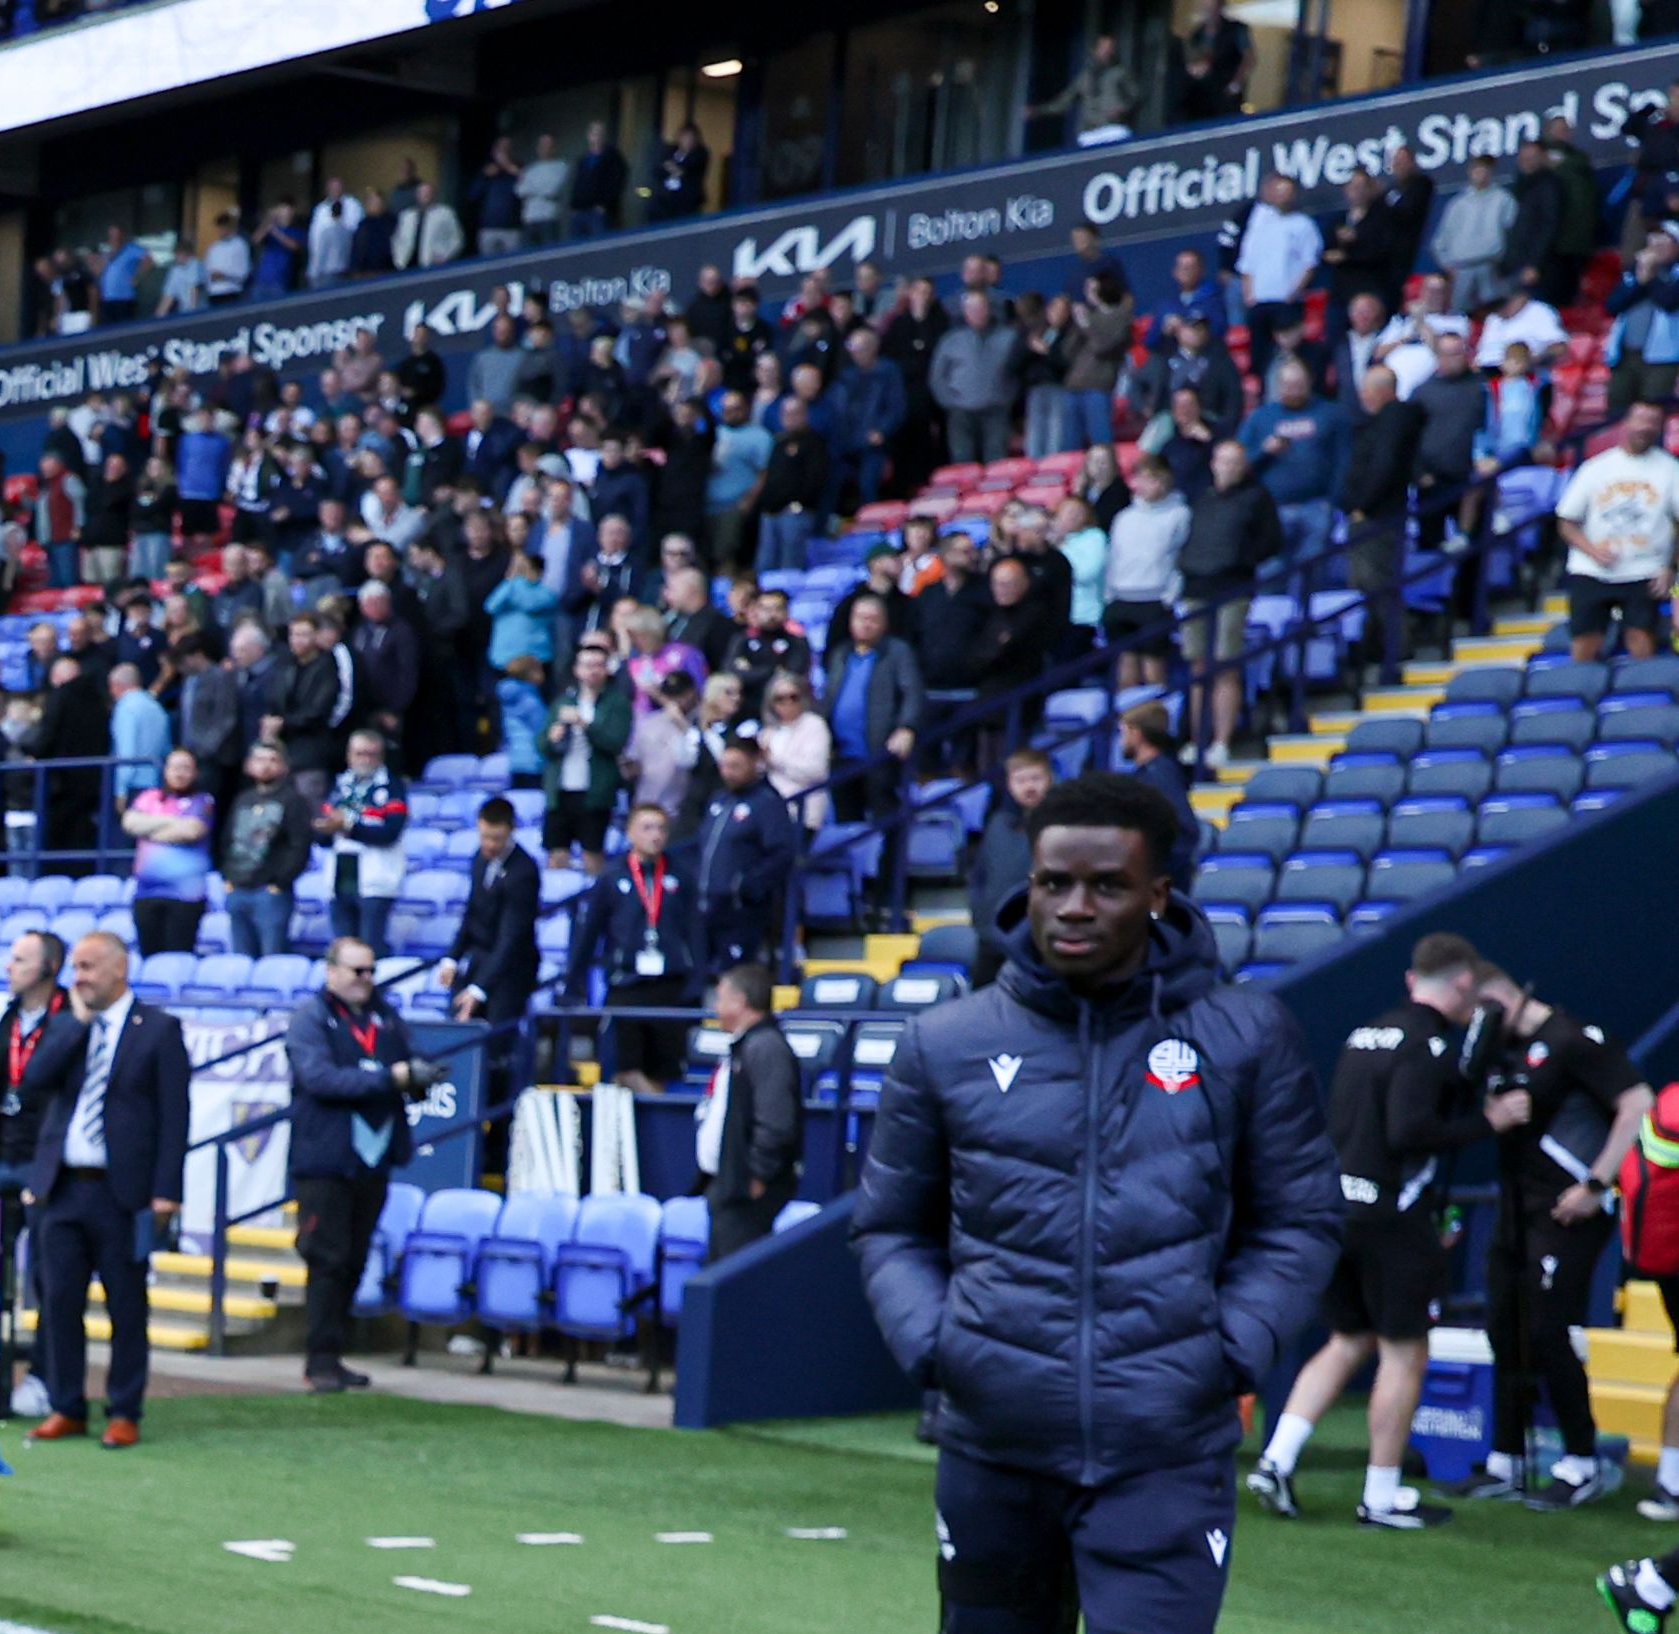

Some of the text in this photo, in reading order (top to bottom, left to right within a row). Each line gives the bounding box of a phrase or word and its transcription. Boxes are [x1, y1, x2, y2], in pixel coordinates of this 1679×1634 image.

[1083, 146, 1261, 226] Official
[1272, 125, 1406, 189] West
[733, 195, 1054, 281] KIA Bolton Kia
